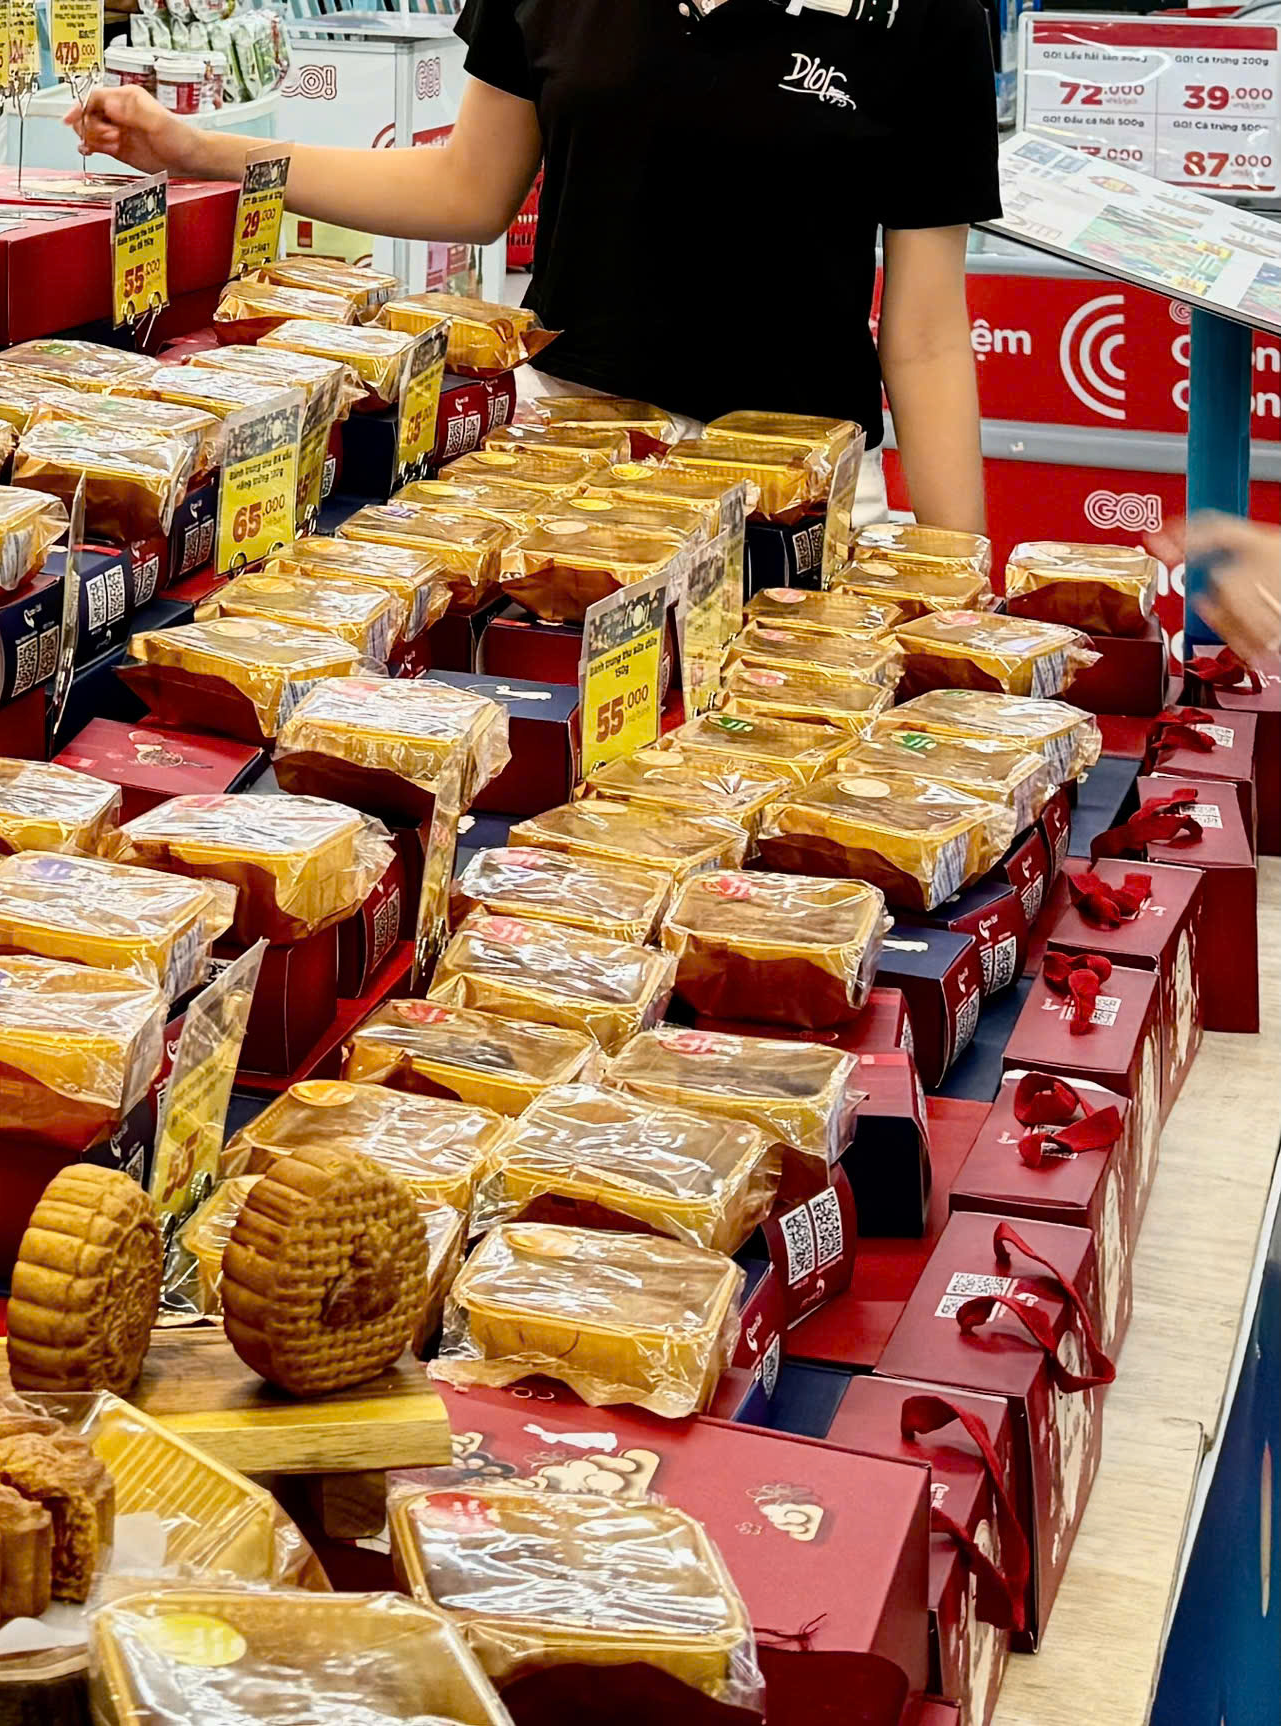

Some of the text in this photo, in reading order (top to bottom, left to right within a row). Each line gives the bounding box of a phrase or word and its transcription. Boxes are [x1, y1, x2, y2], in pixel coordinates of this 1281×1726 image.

[55, 41, 96, 65] 470.000
[1242, 57, 1270, 67] 200g
[281, 65, 338, 100] O!
[781, 53, 850, 104] Dior
[1059, 81, 1145, 105] 72.000
[1183, 85, 1274, 111] 39.000
[1183, 151, 1272, 178] 87.000
[241, 207, 276, 240] 29.000
[123, 258, 161, 298] 55.000
[232, 494, 286, 543] 65.000
[1084, 490, 1163, 534] GO!
[595, 684, 649, 744] 55.000
